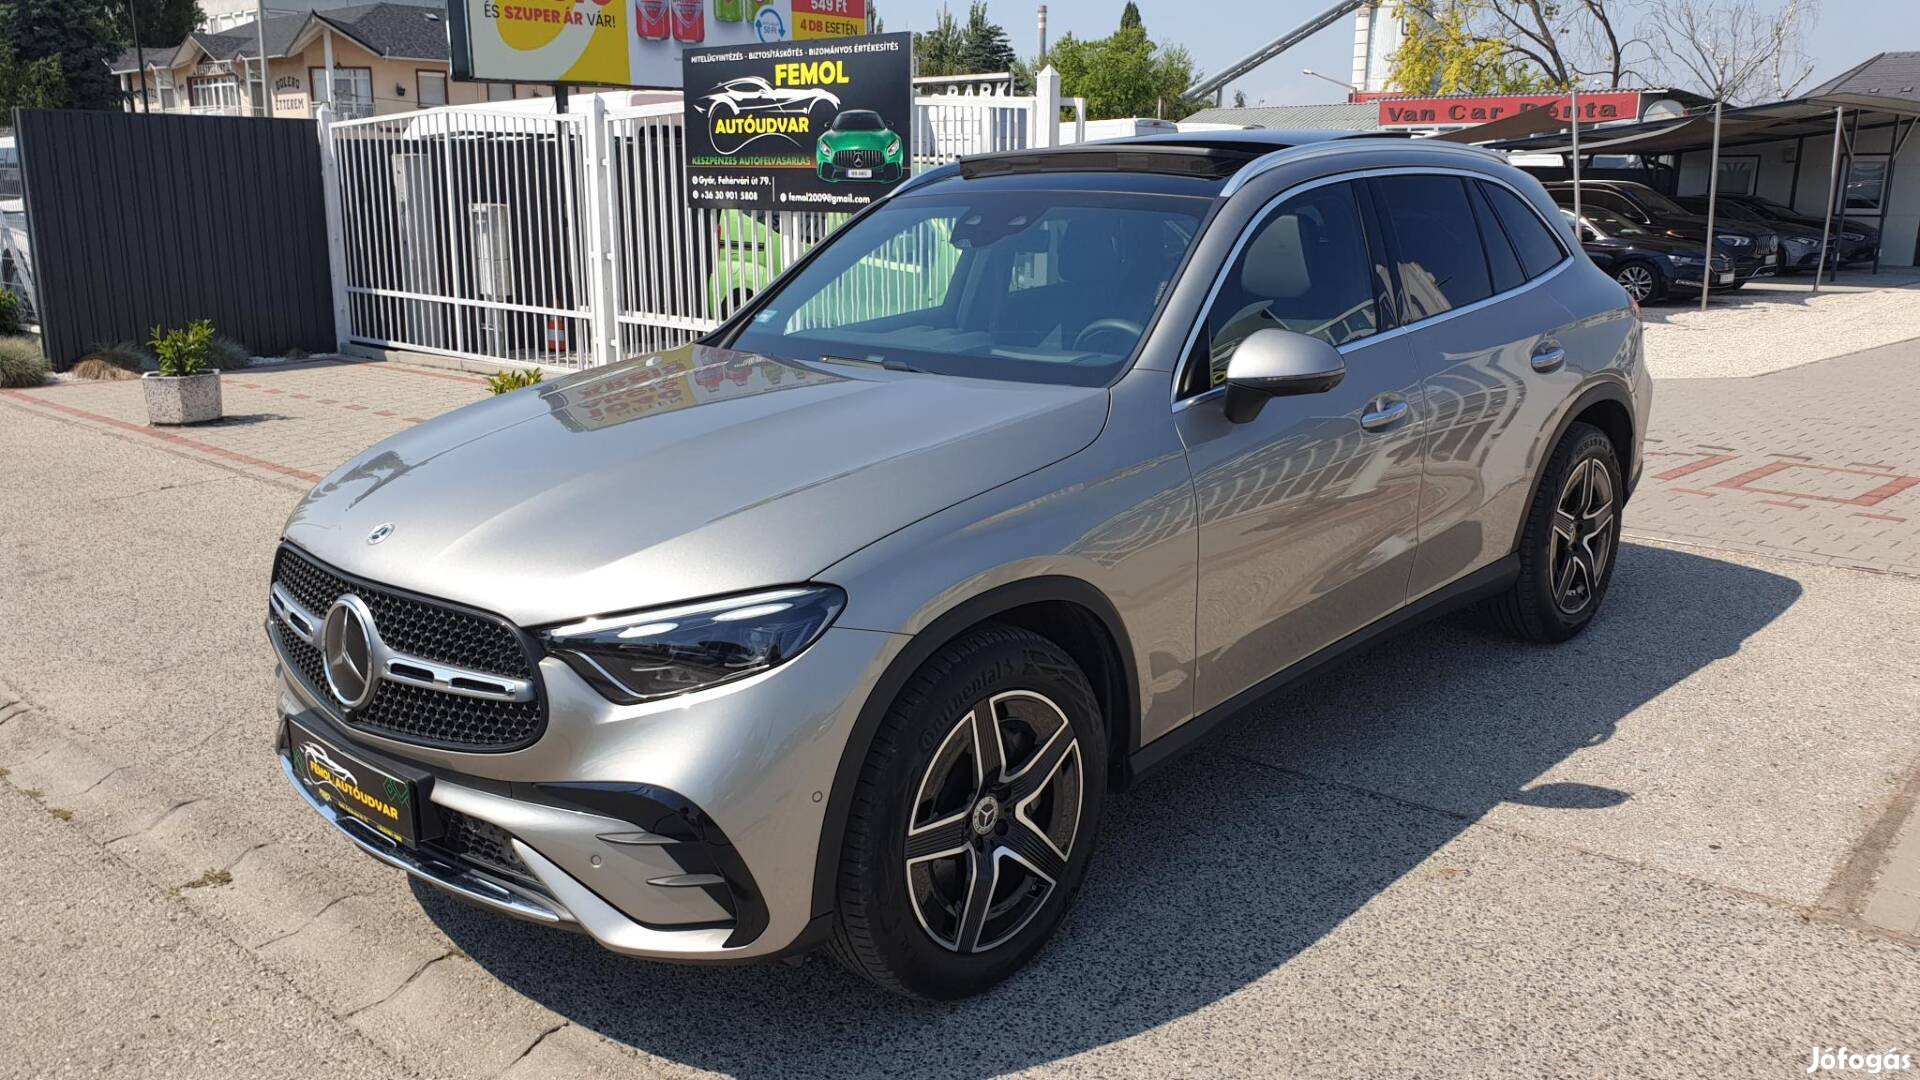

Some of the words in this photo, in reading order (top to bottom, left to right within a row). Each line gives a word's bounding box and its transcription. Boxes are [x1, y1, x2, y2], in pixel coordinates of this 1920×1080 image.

[484, 1, 500, 18] ÉS
[504, 5, 560, 23] SZUPER
[563, 7, 583, 25] ÁR
[586, 11, 616, 28] VÁR!
[800, 19, 807, 31] 4
[808, 20, 823, 32] DB
[825, 21, 858, 35] ESETÉN
[808, 45, 853, 56] BIZOMÁNYOS
[854, 41, 899, 53] ÉRTÉKESÍTÉS
[775, 60, 849, 87] FEMOL
[1388, 107, 1436, 122] Van
[1448, 104, 1504, 121] Car
[715, 114, 809, 134] AUTÓUDVAR
[701, 190, 714, 200] +36
[715, 190, 724, 200] 30
[725, 190, 738, 200] 901
[309, 760, 333, 785] FEMOL
[334, 780, 400, 821] AUTÓUDVAR
